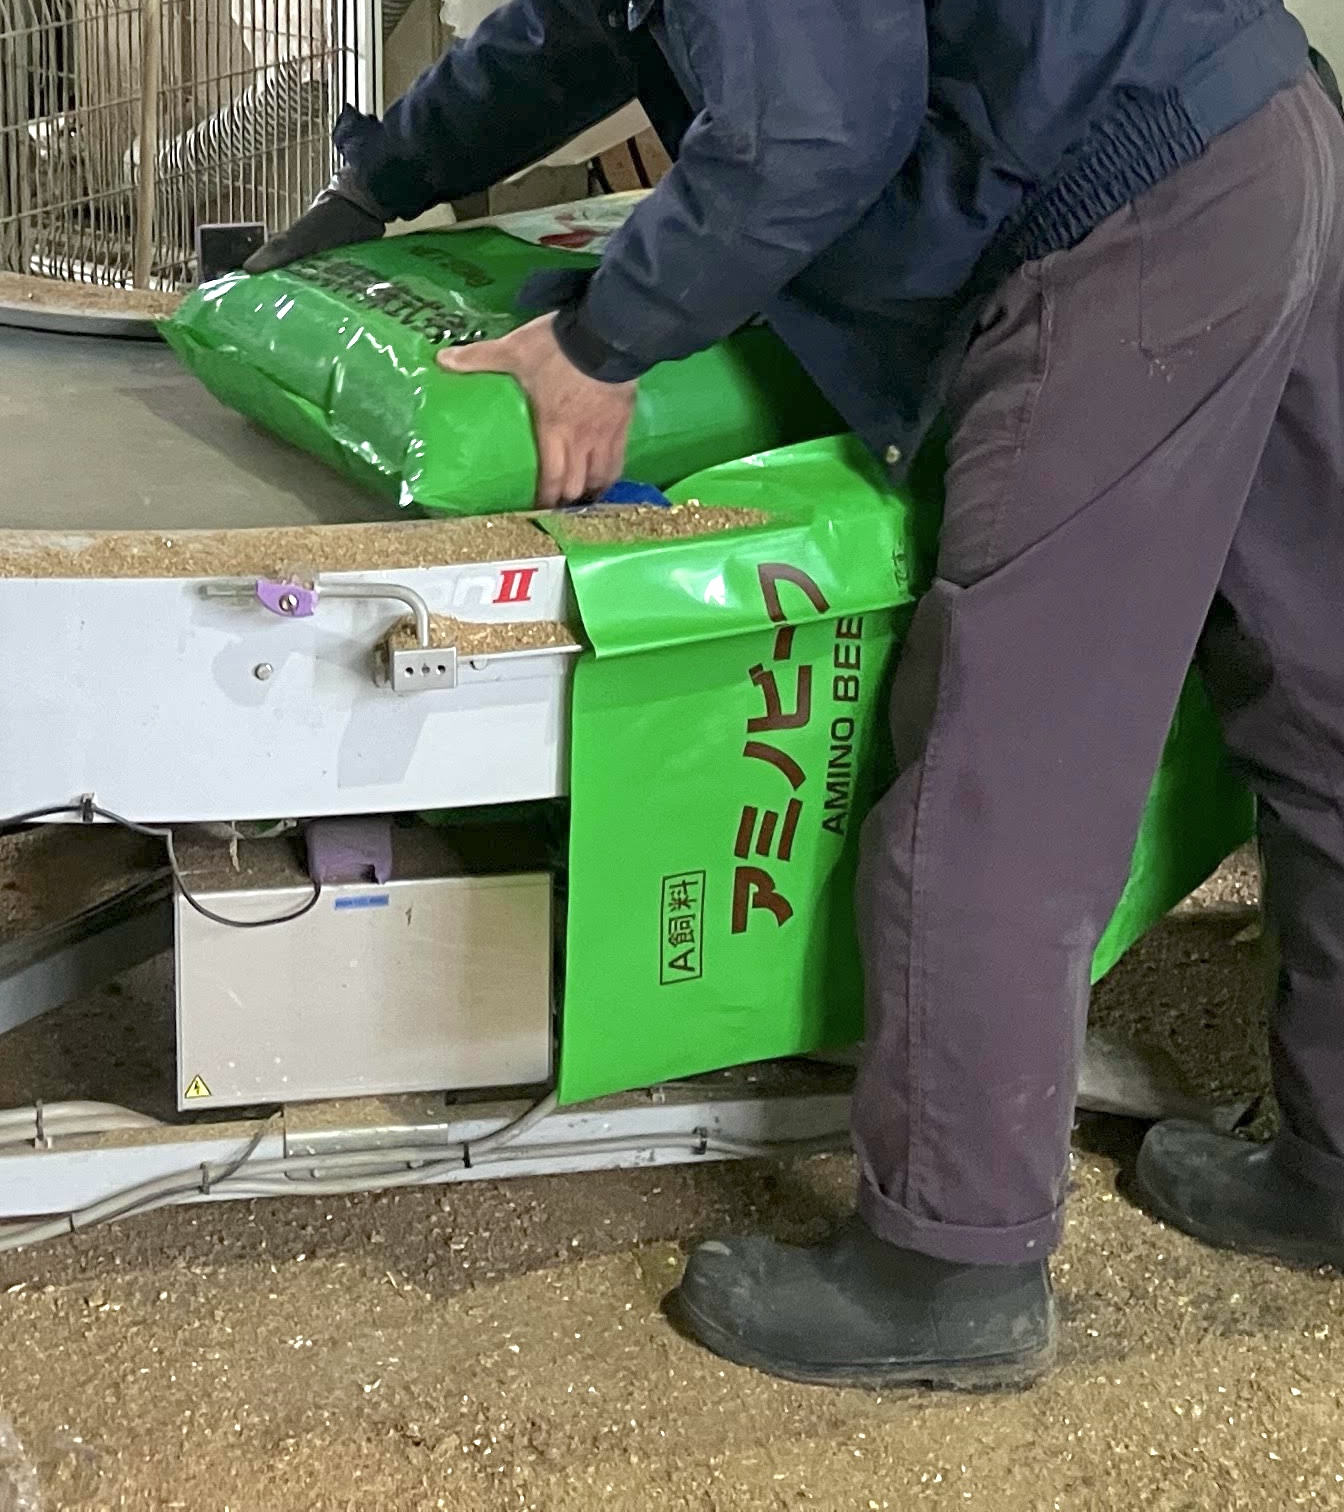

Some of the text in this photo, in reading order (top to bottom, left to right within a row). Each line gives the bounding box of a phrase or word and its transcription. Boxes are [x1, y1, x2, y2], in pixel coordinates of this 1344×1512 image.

[731, 561, 831, 935] アミノビーフ
[821, 616, 864, 836] AMINO BEE
[667, 879, 698, 972] A飼料
